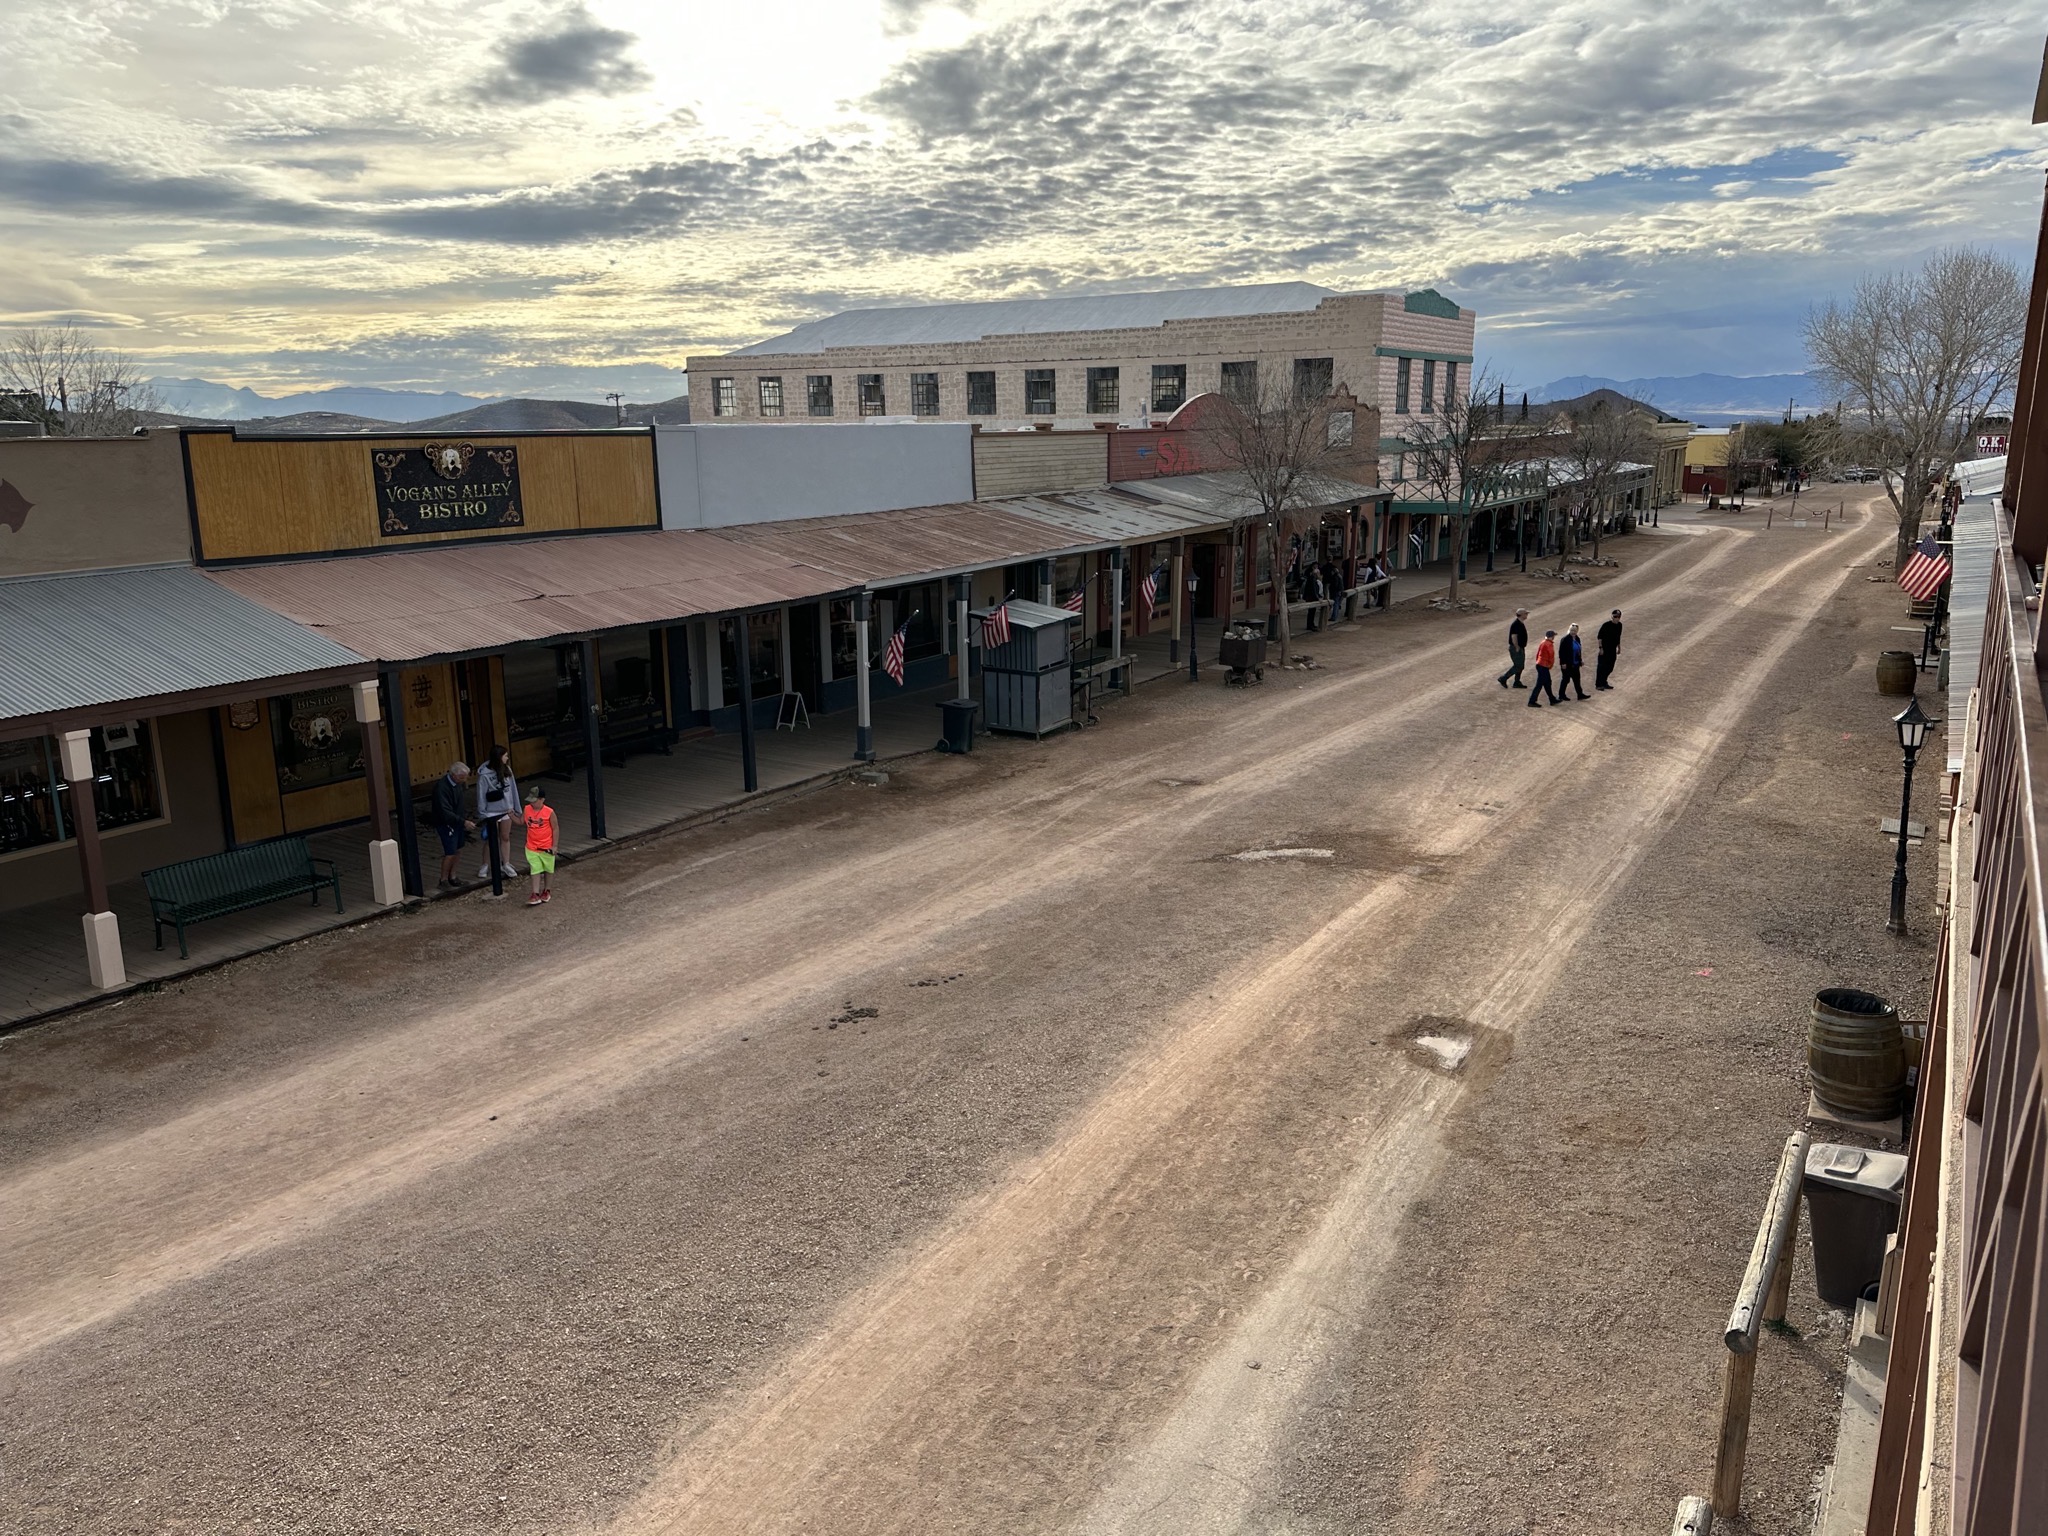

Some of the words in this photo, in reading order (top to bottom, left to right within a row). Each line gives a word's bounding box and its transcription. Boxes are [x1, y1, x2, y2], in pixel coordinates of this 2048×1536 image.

[1980, 436, 2002, 448] O.K.
[386, 485, 458, 502] VOGAN'S
[462, 480, 512, 498] ALLEY
[419, 501, 487, 519] BISTRO
[297, 695, 338, 710] BISTRO
